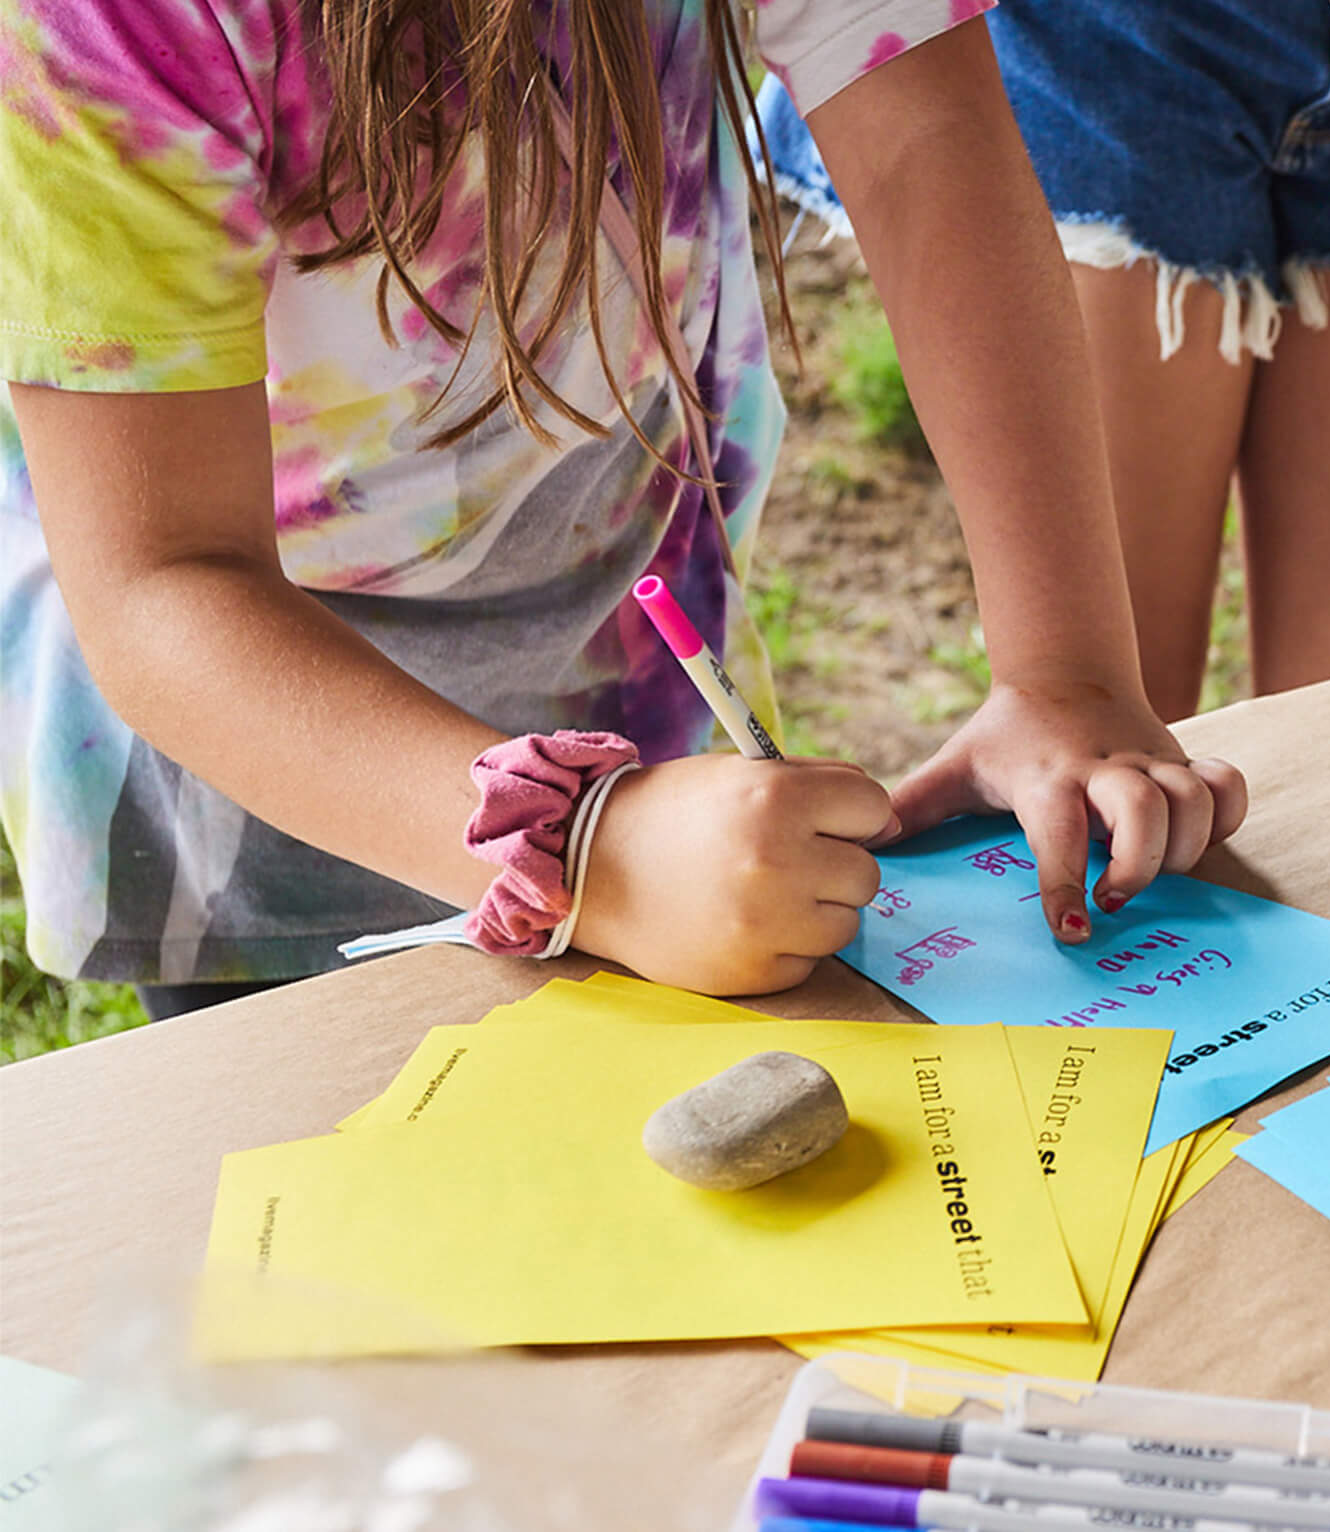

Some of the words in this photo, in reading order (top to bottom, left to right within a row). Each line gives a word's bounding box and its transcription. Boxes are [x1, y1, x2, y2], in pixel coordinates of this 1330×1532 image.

[1264, 1009, 1288, 1022] a
[912, 1055, 943, 1064] I
[1067, 1045, 1097, 1054] I
[915, 1069, 943, 1103] am
[1055, 1056, 1085, 1089] am
[923, 1107, 956, 1139] for
[1044, 1094, 1083, 1128] for
[931, 1143, 955, 1157] a
[1038, 1131, 1062, 1144] a
[936, 1161, 982, 1245] street
[957, 1248, 993, 1300] that
